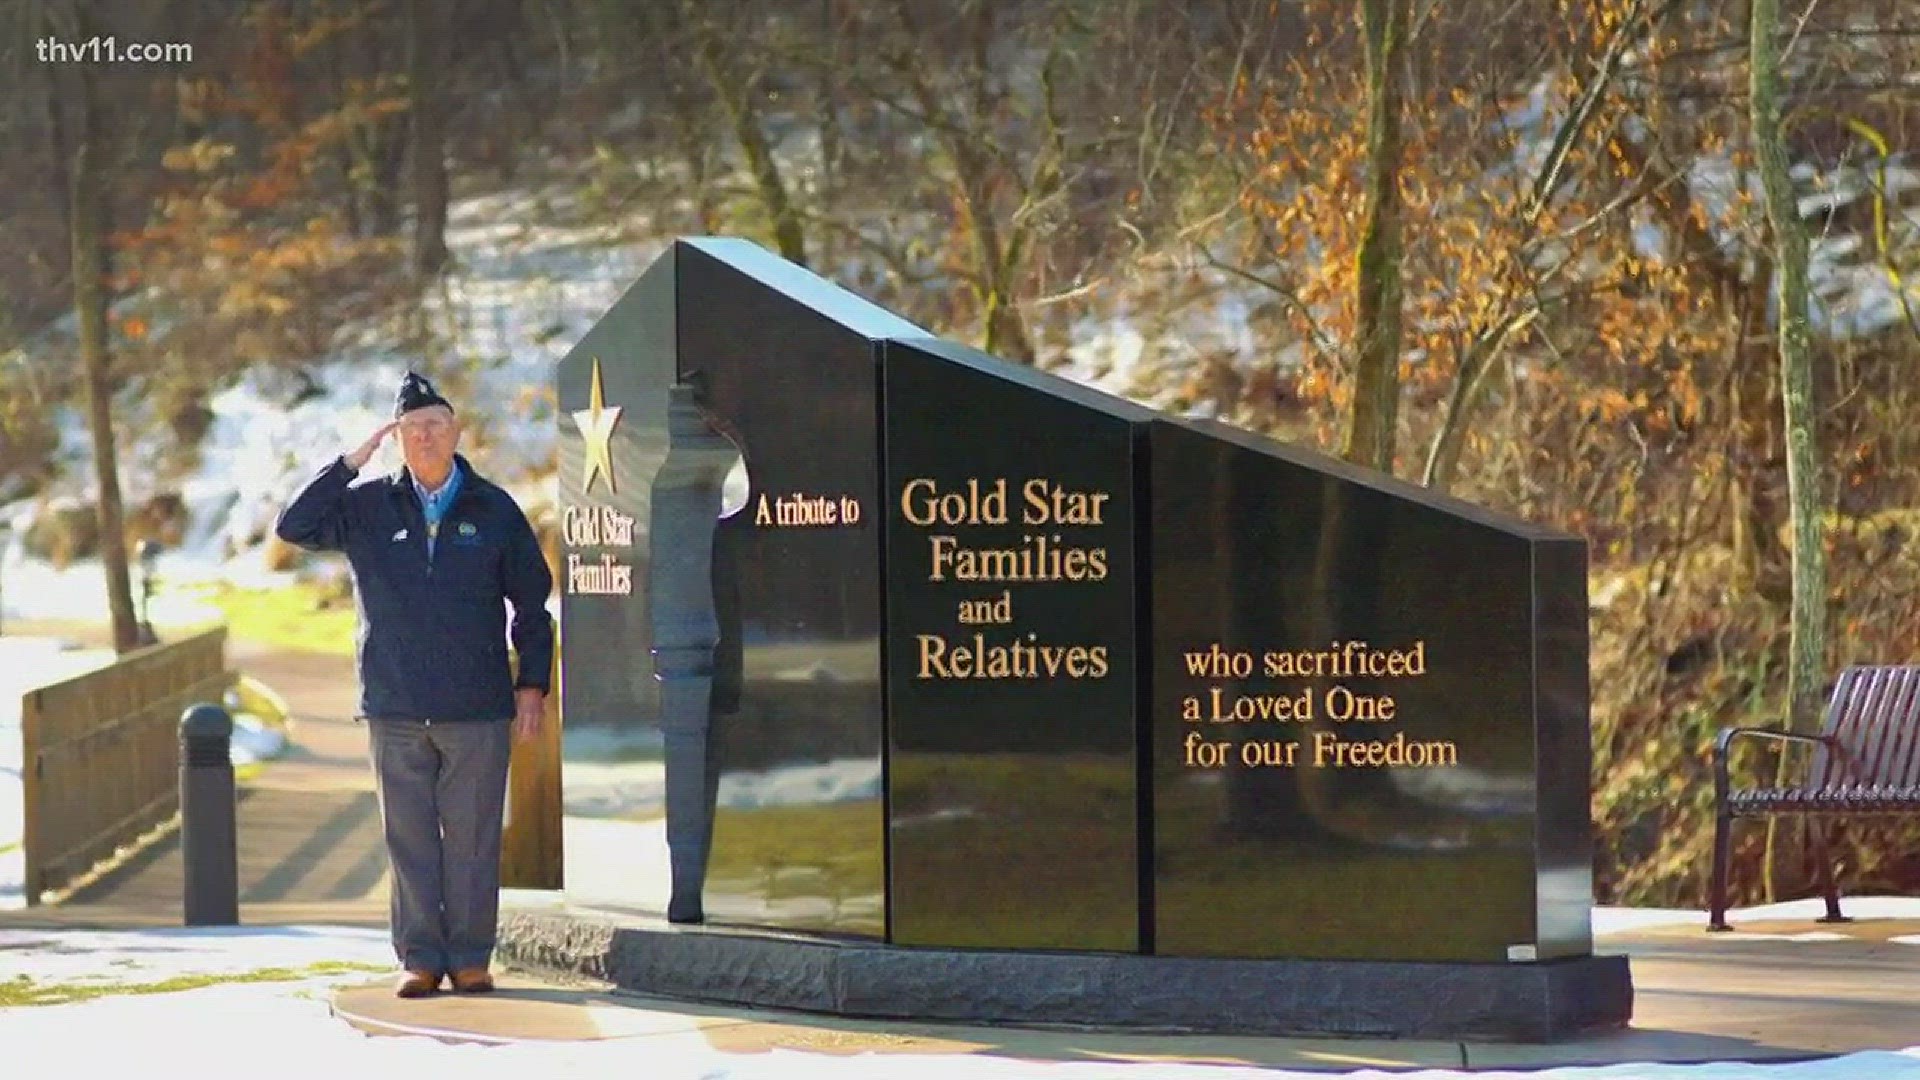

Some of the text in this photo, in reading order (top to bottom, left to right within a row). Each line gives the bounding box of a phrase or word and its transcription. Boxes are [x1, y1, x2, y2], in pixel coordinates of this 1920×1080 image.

[755, 492, 860, 526] A tribute to
[901, 477, 1109, 526] Gold Star
[563, 505, 635, 547] Gold Star
[568, 553, 633, 595] Families
[928, 534, 1108, 582] Families
[958, 589, 1013, 624] and
[916, 631, 1109, 679] Relatives
[1183, 640, 1427, 677] who sacrificed
[1182, 685, 1396, 722] a Loved One
[1184, 730, 1458, 768] for our Freedom
